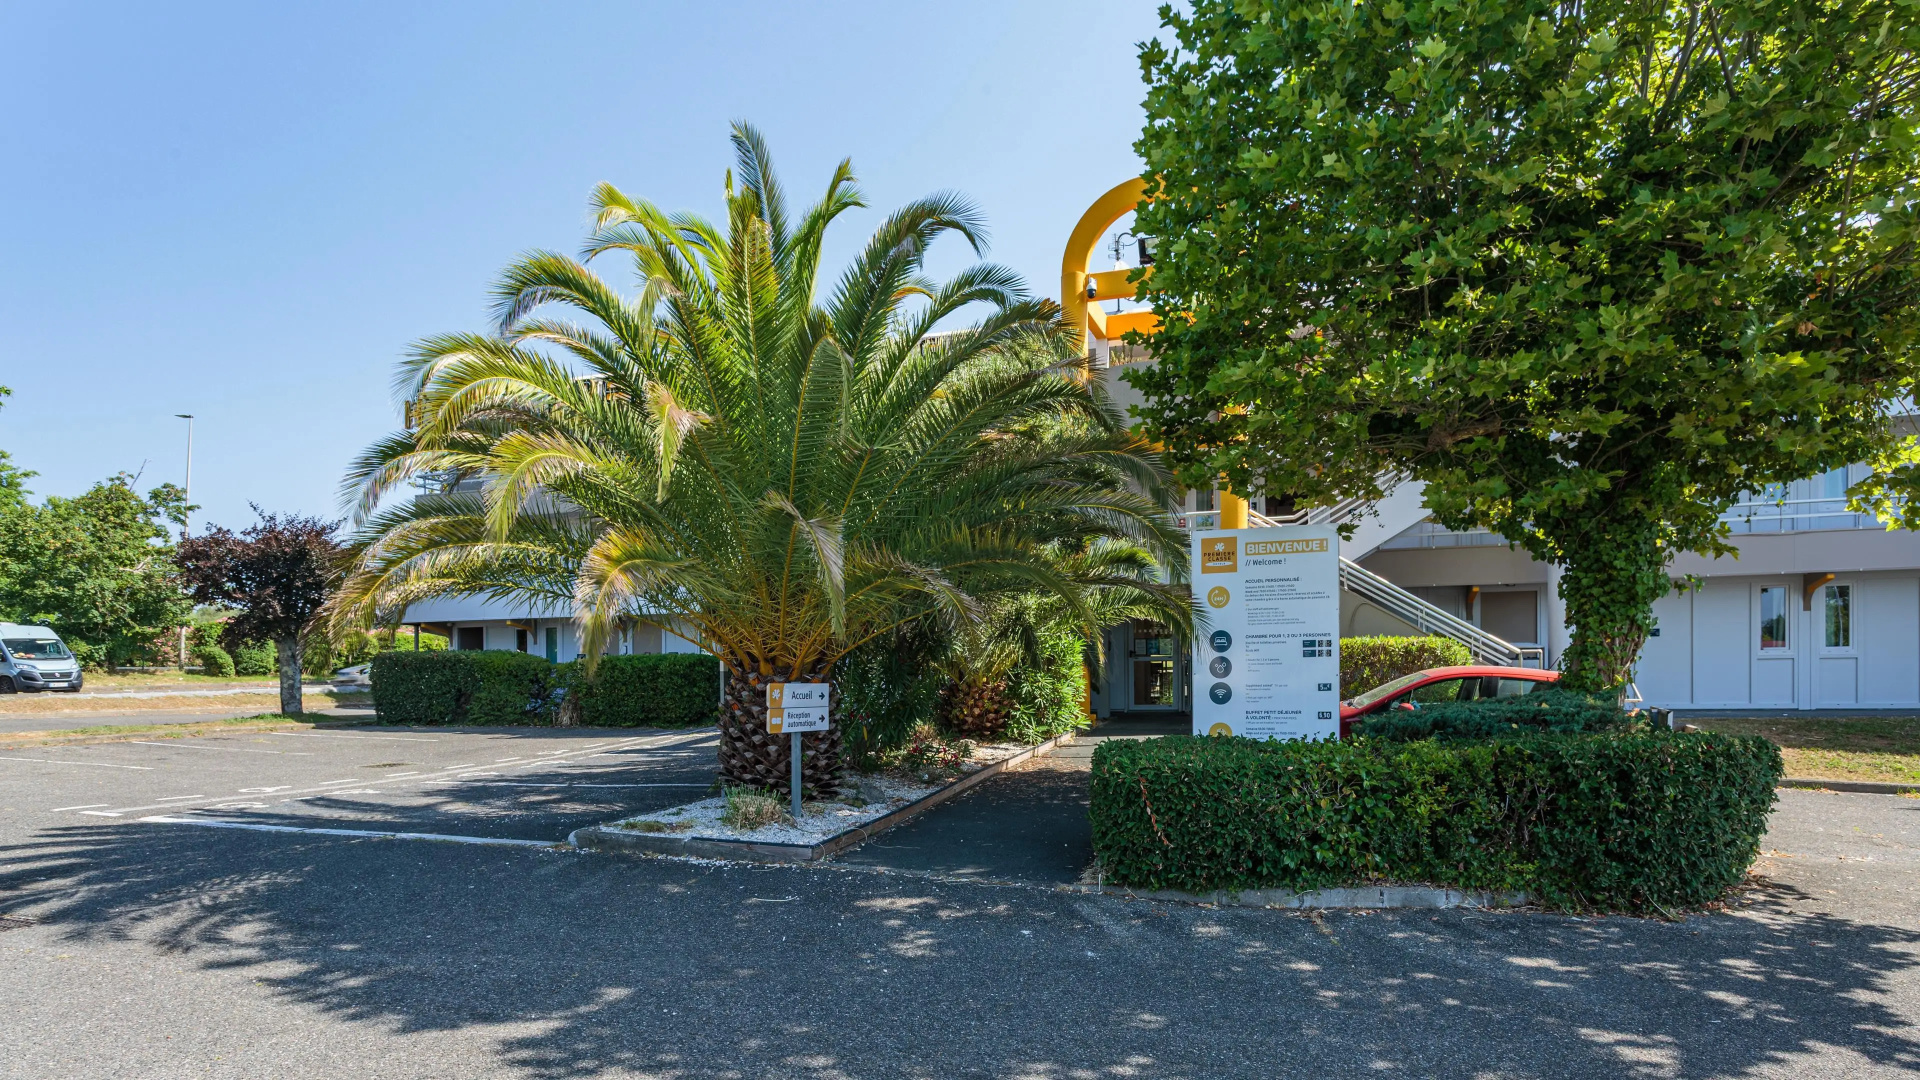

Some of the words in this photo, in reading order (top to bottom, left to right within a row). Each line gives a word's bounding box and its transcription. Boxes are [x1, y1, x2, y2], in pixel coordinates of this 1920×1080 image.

[1246, 540, 1320, 554] BIENVENUE
[1322, 540, 1327, 550] !
[791, 690, 813, 700] Accueil
[787, 711, 811, 720] Réception
[787, 720, 817, 728] automatique
